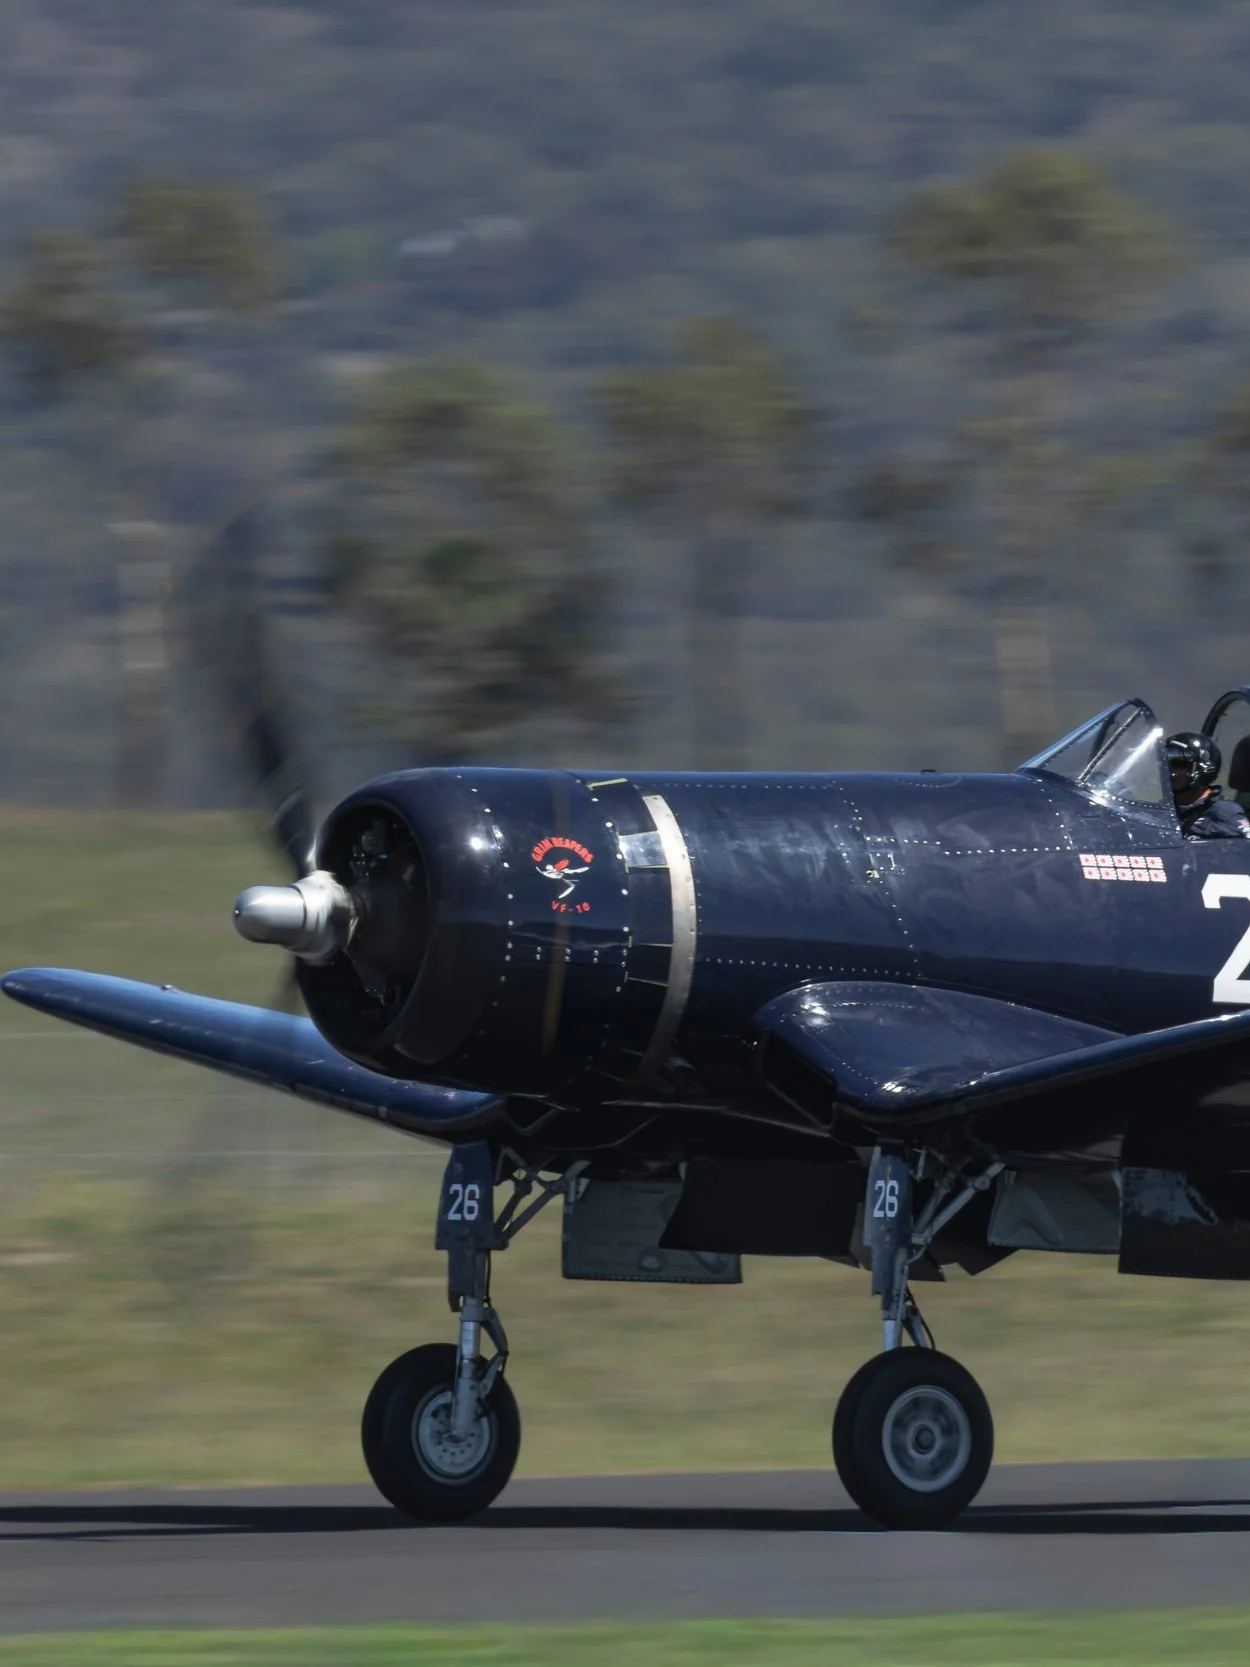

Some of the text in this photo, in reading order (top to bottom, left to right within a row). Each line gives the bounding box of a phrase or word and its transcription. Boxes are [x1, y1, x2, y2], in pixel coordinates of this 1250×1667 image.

[531, 836, 595, 864] GRIM REAPERS
[551, 900, 592, 914] VF-10
[447, 1183, 480, 1221] 26
[873, 1180, 899, 1218] 26
